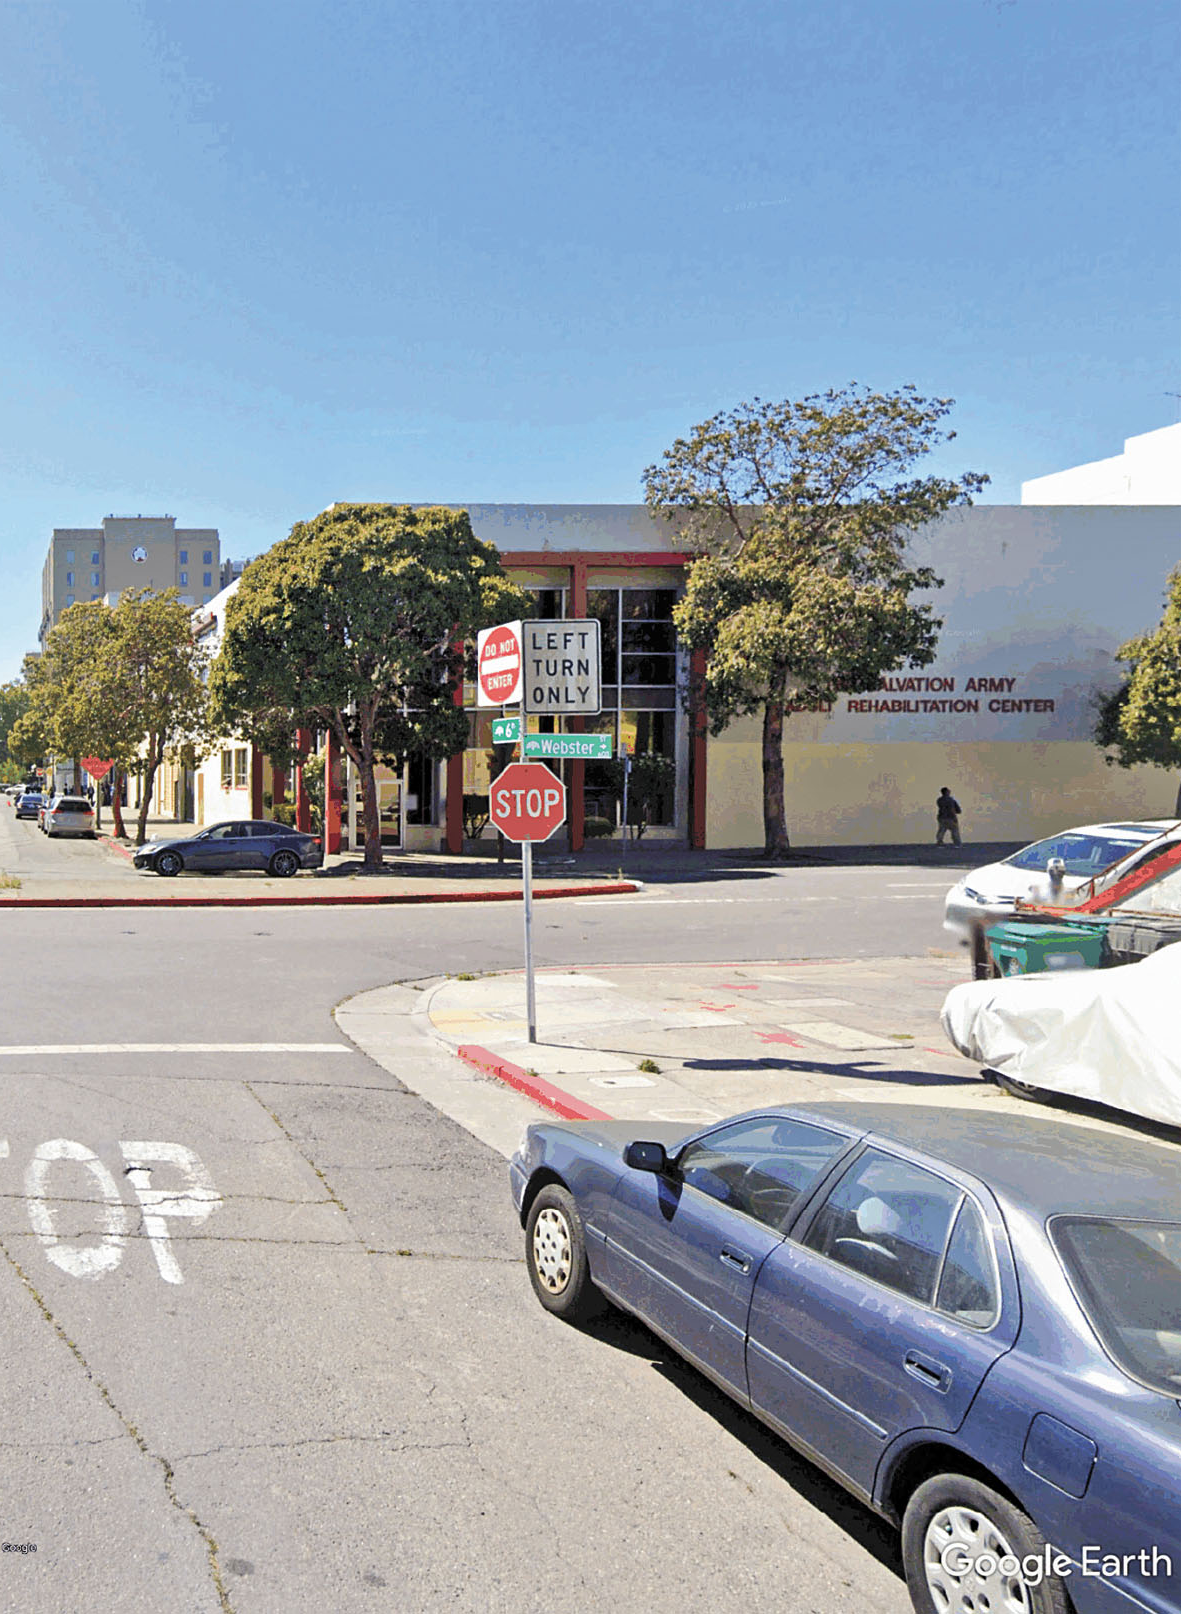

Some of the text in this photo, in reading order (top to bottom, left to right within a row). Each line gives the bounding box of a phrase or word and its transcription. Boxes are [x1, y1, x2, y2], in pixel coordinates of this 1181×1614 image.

[485, 638, 516, 657] DO NOT
[532, 632, 589, 650] LEFT
[532, 659, 590, 677] TURN
[487, 674, 513, 691] ENTER
[879, 676, 1016, 693] ALVATION ARMY
[532, 686, 590, 704] ONLY
[847, 699, 979, 713] REHABILITATION
[988, 699, 1055, 713] CENTER
[541, 738, 595, 755] Webster
[495, 788, 560, 818] STOP
